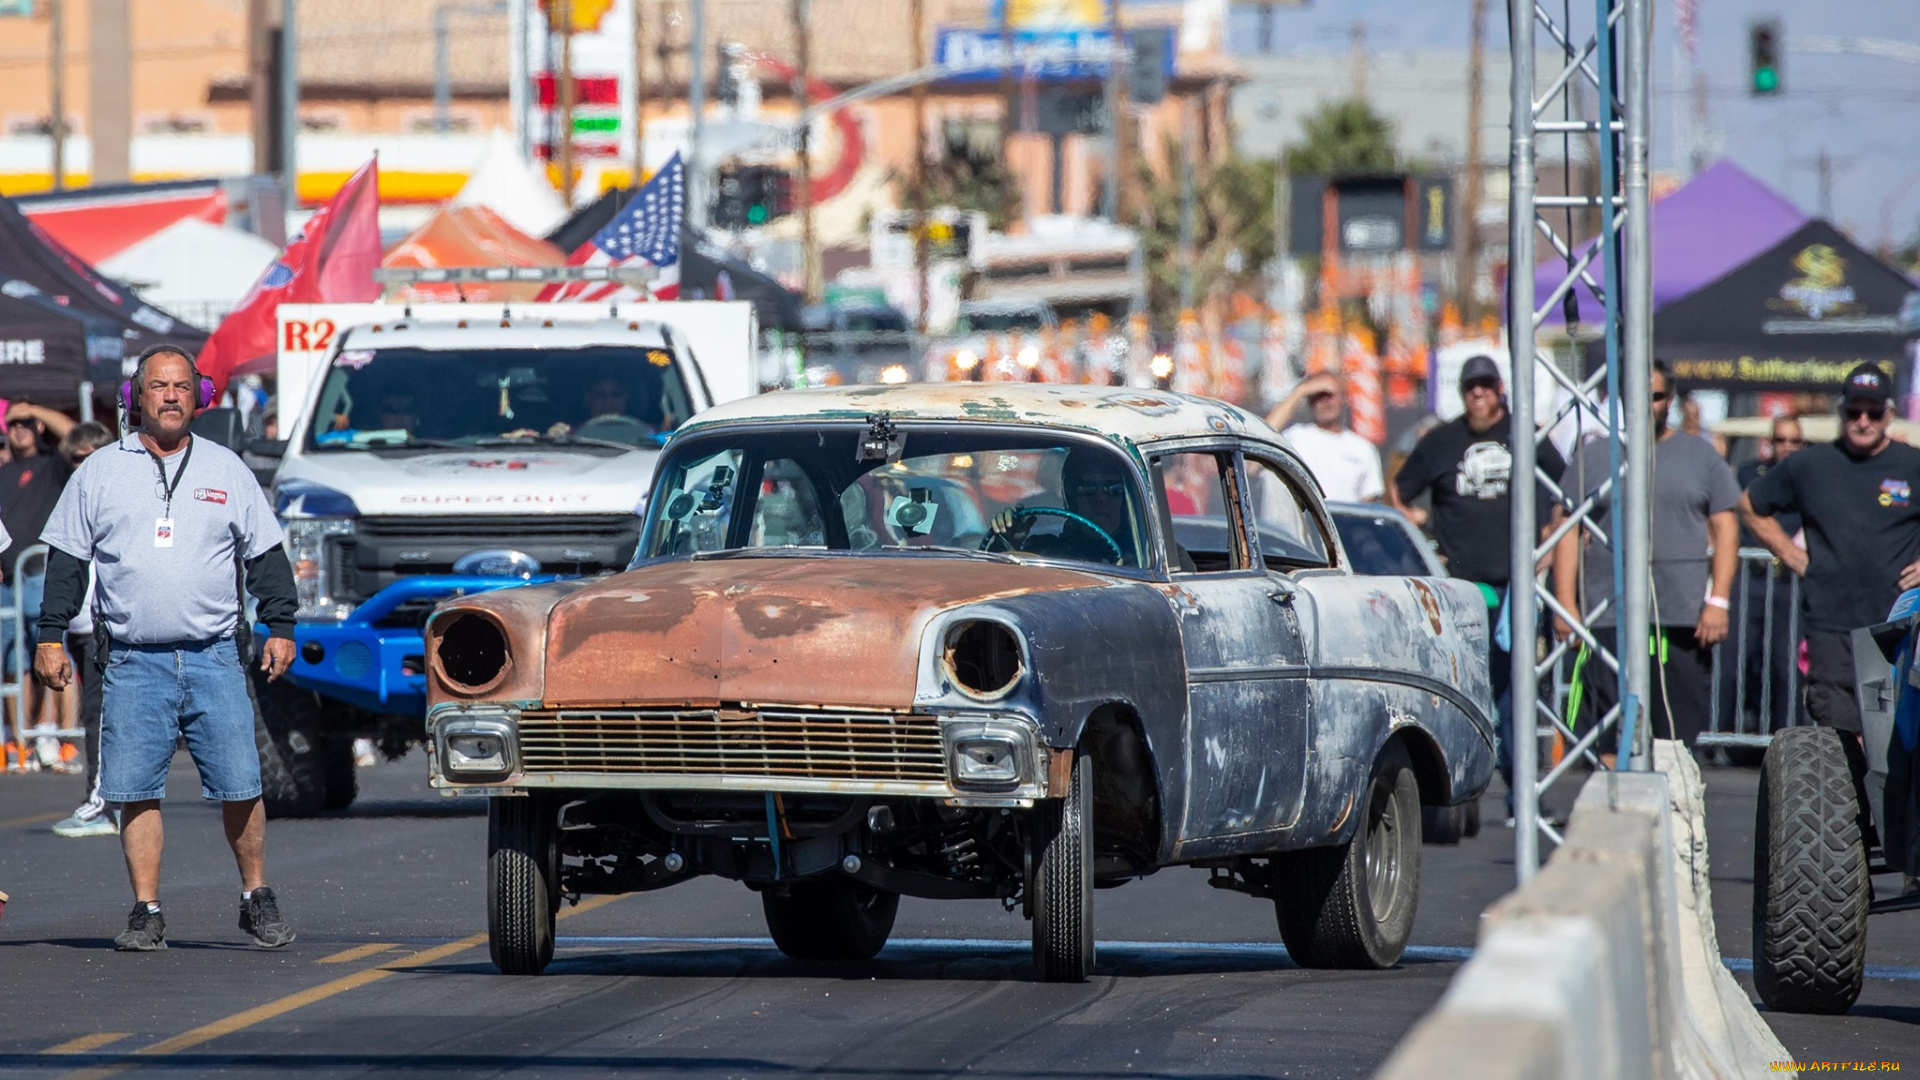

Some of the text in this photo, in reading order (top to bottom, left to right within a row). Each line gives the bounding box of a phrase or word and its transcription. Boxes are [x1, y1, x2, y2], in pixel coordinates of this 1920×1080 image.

[284, 319, 337, 352] R2
[400, 493, 591, 503] SUPER DUTY
